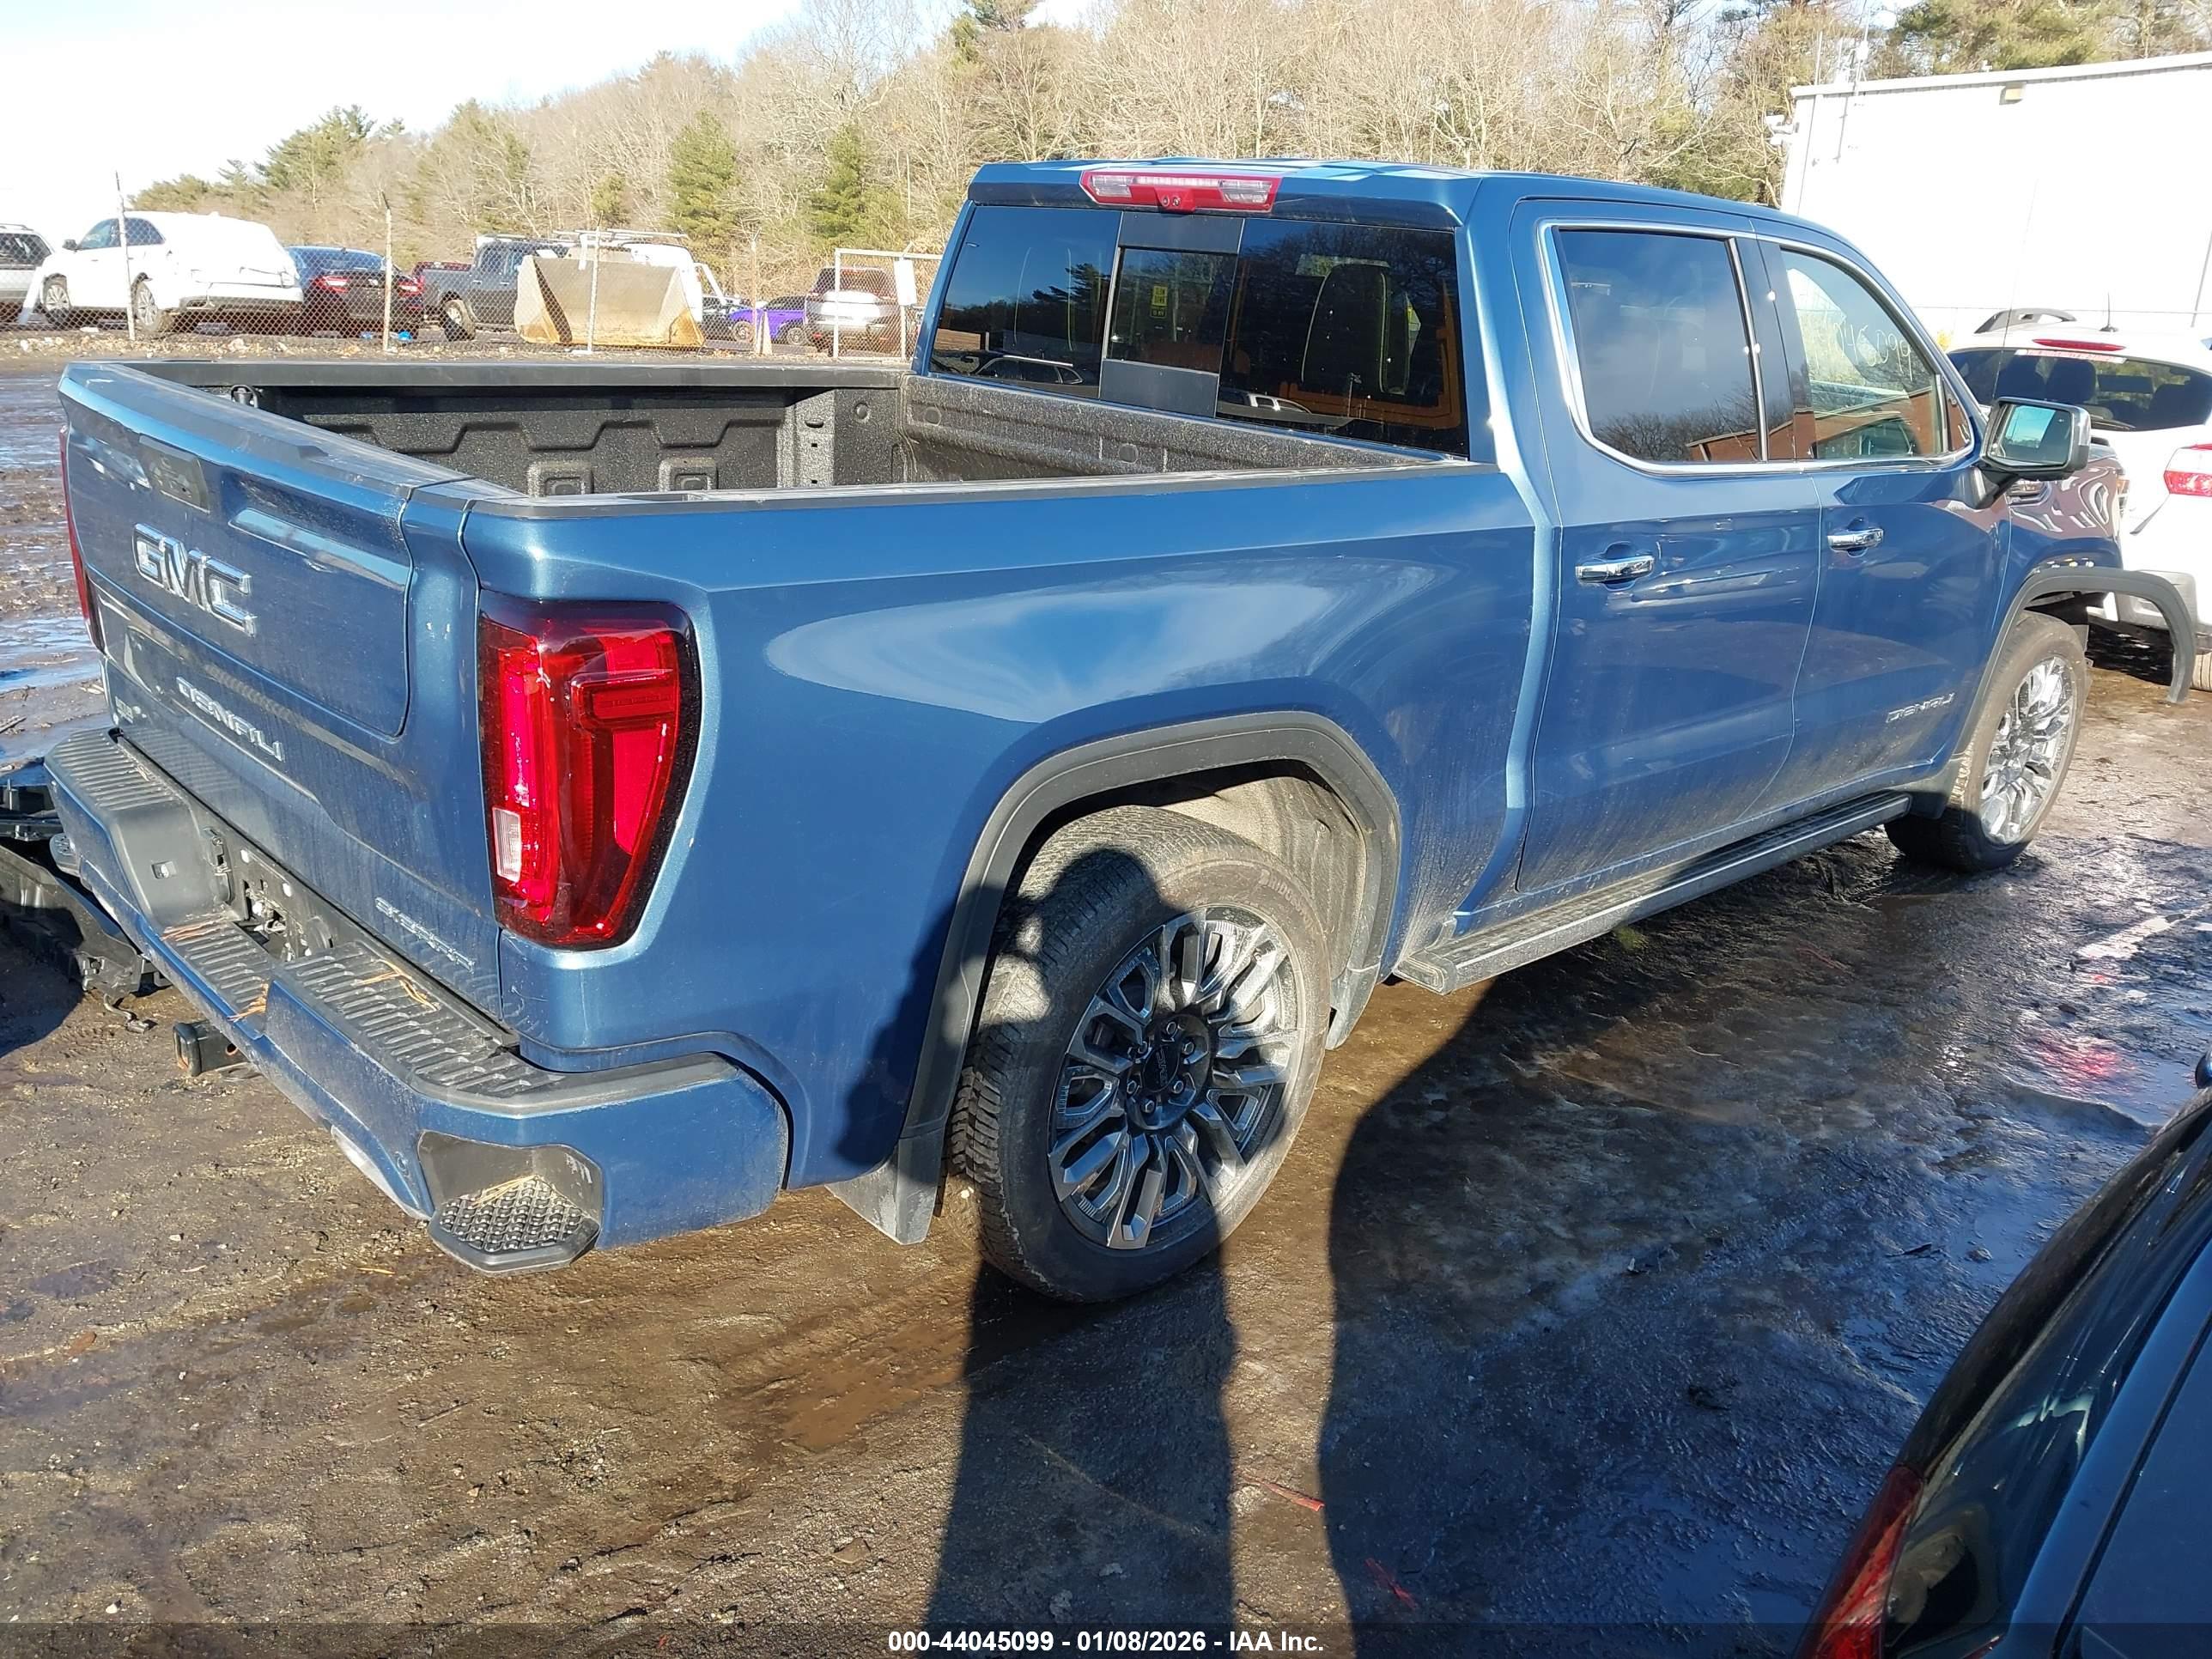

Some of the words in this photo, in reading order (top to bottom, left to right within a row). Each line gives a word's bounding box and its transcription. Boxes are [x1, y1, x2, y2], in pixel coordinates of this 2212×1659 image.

[132, 522, 255, 638] GMC
[176, 676, 285, 763] DENALI
[1886, 692, 1955, 723] DENALI
